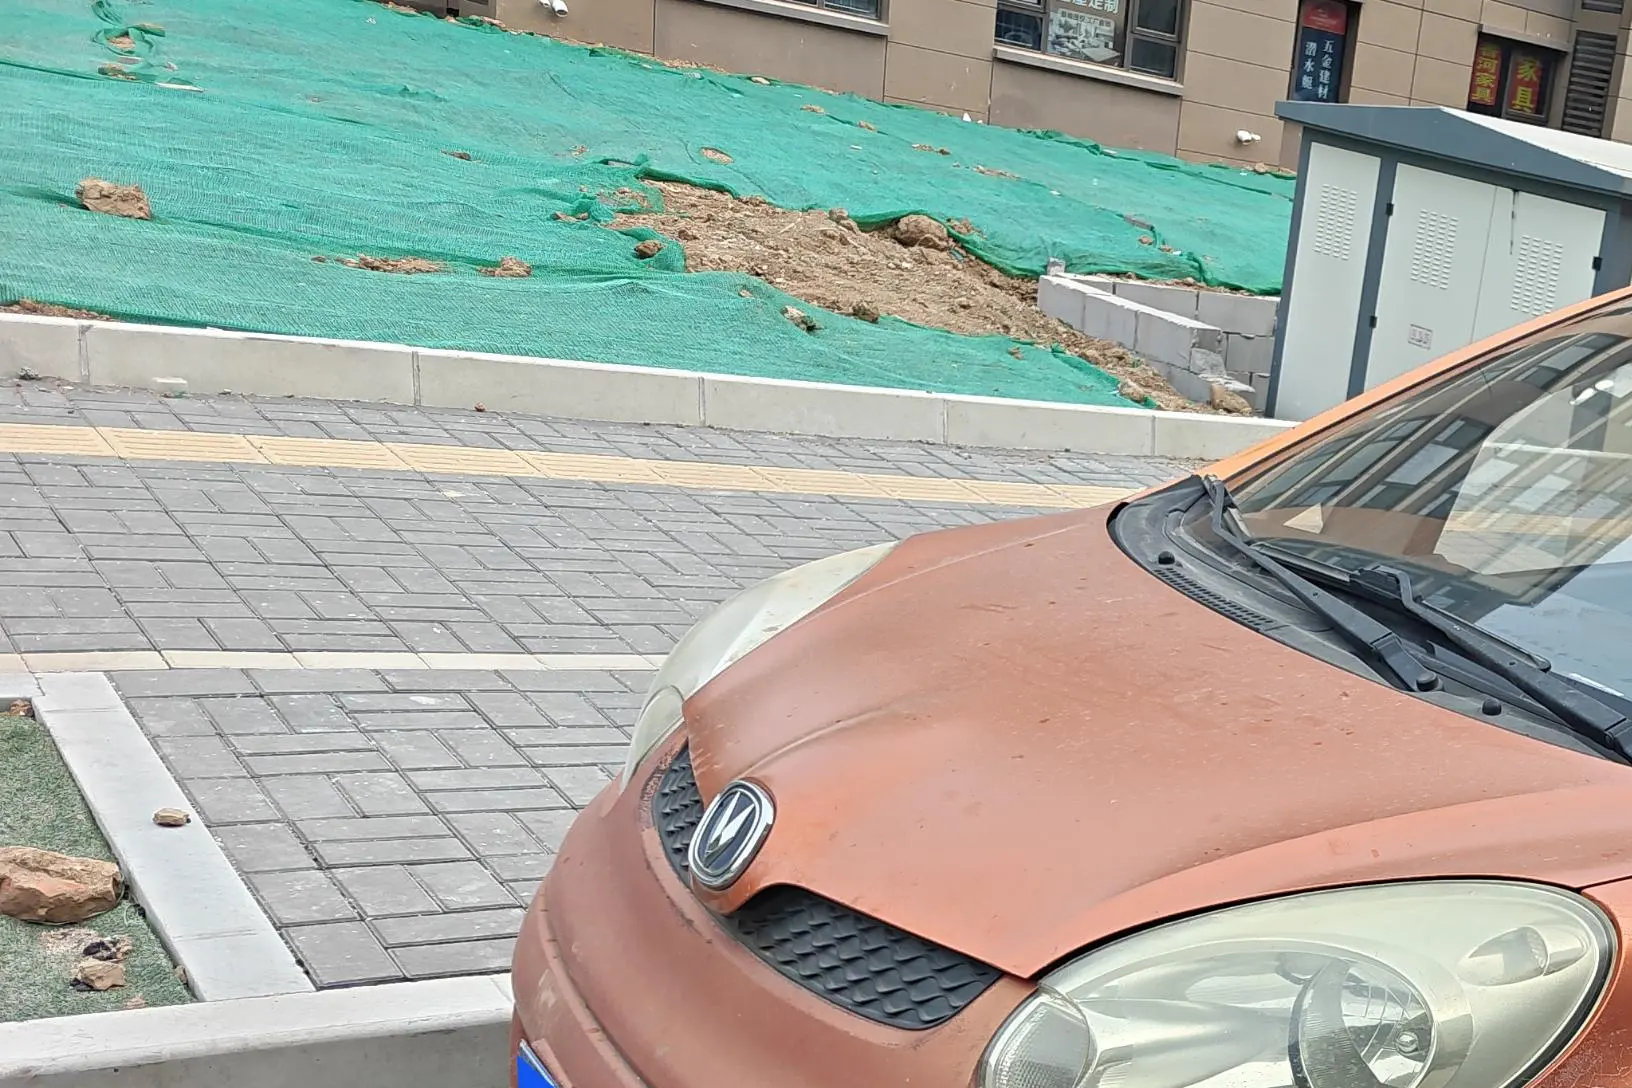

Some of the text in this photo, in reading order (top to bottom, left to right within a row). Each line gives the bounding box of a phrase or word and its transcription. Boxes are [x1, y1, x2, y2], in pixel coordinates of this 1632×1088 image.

[1317, 39, 1335, 99] 五金建材
[1511, 55, 1541, 113] 家具
